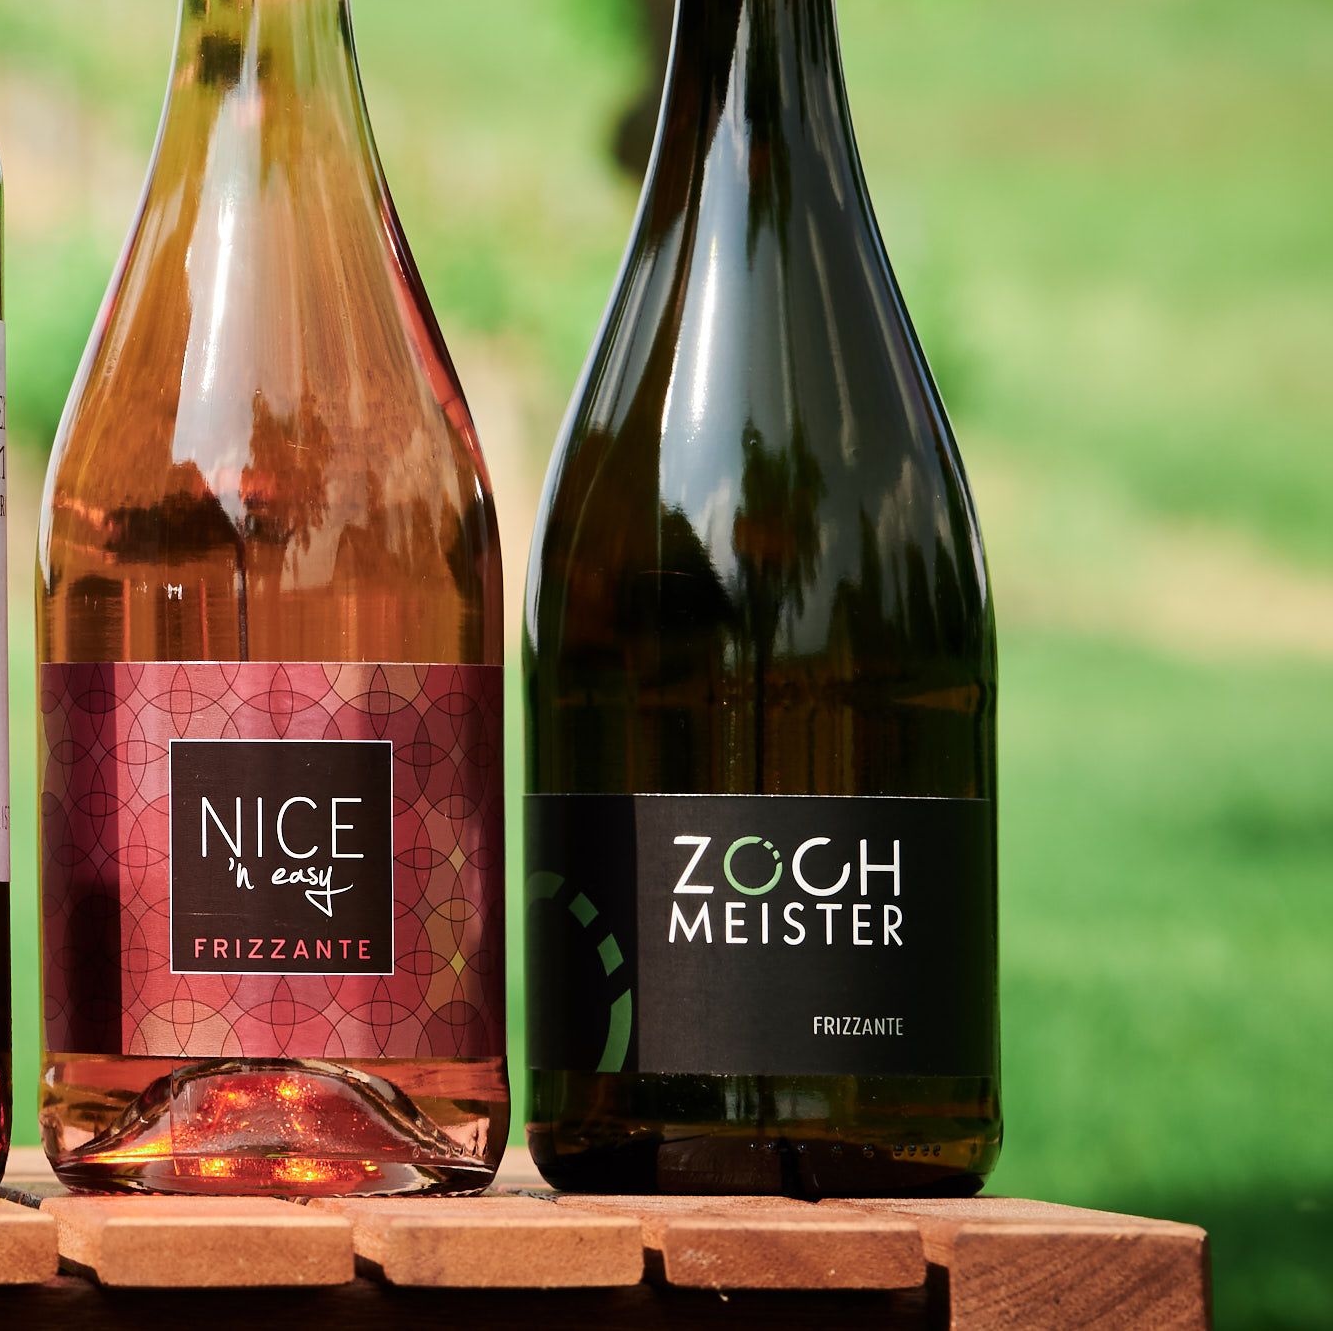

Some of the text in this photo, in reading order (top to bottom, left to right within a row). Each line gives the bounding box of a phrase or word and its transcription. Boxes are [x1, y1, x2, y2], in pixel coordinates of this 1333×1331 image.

[200, 795, 365, 860] NICE
[271, 865, 354, 918] easy
[668, 900, 904, 947] MEISTER
[193, 937, 372, 960] FRIZZANTE
[812, 1016, 904, 1037] FRIZZANTE
